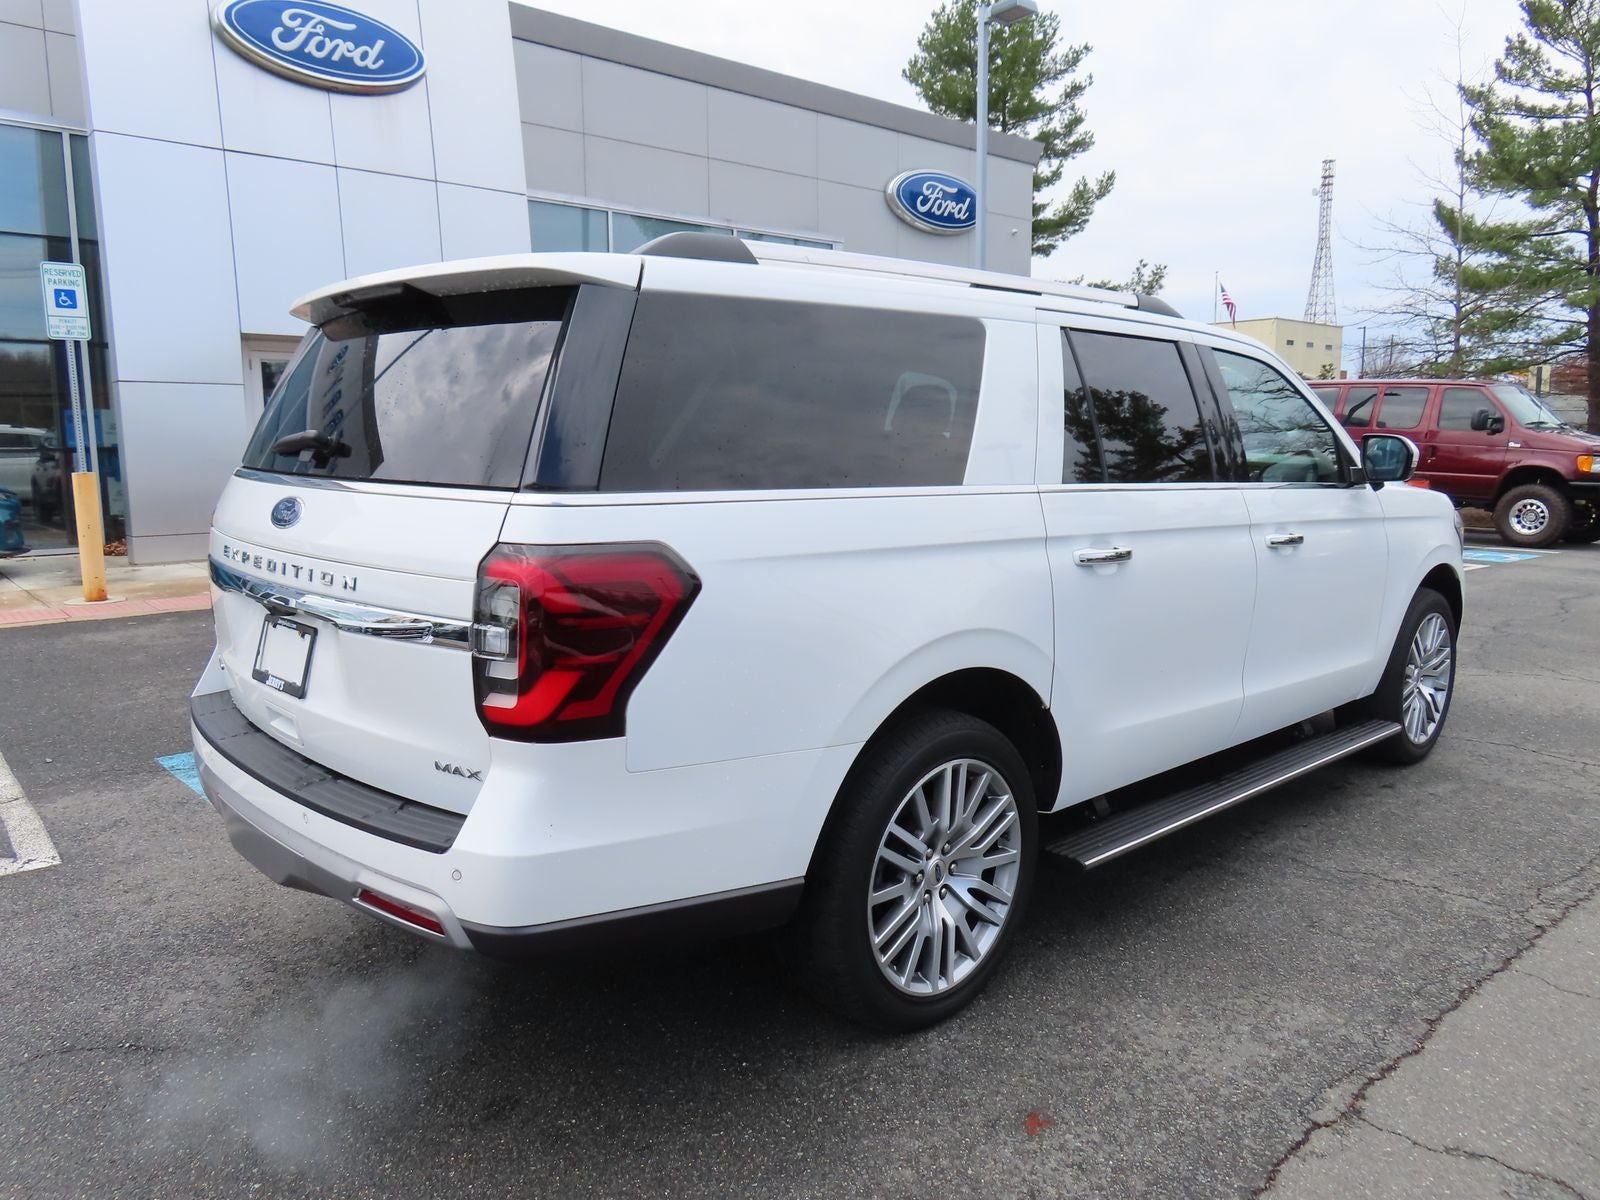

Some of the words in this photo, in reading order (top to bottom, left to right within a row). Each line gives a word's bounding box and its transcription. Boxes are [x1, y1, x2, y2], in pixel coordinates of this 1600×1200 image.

[271, 8, 384, 70] Ford
[916, 181, 971, 220] Ford
[44, 268, 81, 278] RESERVED
[48, 278, 80, 287] PARKING
[223, 544, 357, 592] EXPEDITION
[434, 760, 482, 782] MAX
